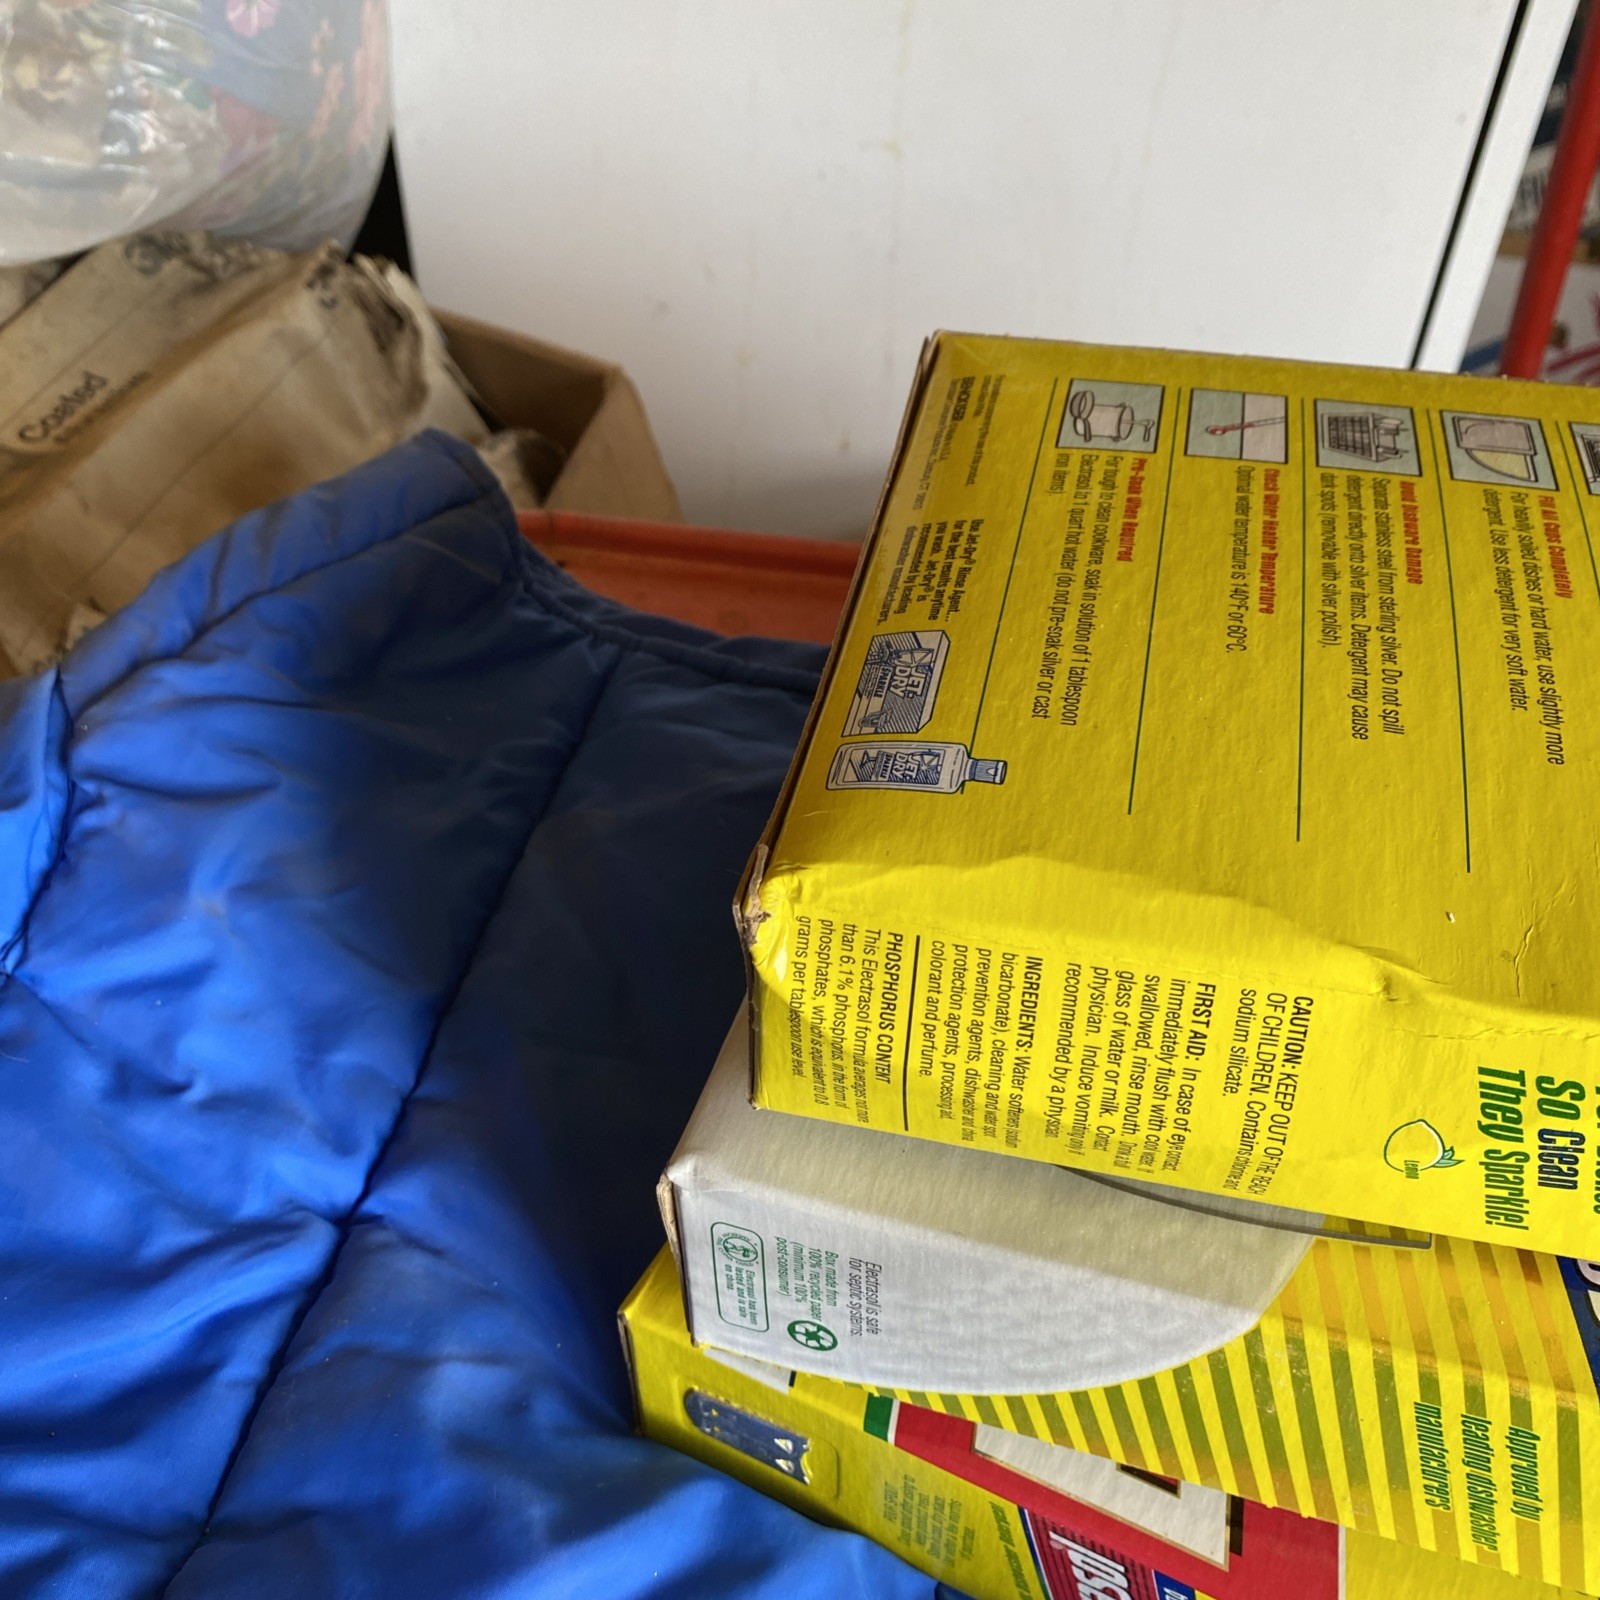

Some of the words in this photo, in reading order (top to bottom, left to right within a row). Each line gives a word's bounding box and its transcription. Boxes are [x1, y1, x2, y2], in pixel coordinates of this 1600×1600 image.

[1127, 457, 1147, 494] Pre-Soak
[1067, 508, 1085, 530] quart
[1095, 501, 1115, 523] clean
[1123, 496, 1140, 519] When
[1064, 530, 1084, 545] hot
[1085, 523, 1109, 567] cookware,
[1116, 521, 1138, 562] Required
[1230, 518, 1251, 570] temperature
[1374, 510, 1393, 548] stainless
[1059, 546, 1078, 571] water
[1348, 542, 1367, 563] onto
[1376, 548, 1395, 570] steel
[1492, 546, 1510, 565] less
[1517, 534, 1539, 561] soiled
[1055, 572, 1076, 588] (do
[1083, 568, 1102, 591] soak
[1349, 564, 1368, 591] silver
[1377, 571, 1396, 594] from
[1493, 565, 1518, 612] detergent
[1521, 561, 1542, 592] dishes
[1052, 589, 1071, 605] not
[1350, 591, 1368, 620] items.
[1044, 606, 1066, 650] pre-soak
[1074, 602, 1097, 637] solution
[1376, 595, 1398, 634] sterling
[1529, 605, 1549, 630] hard
[1072, 638, 1092, 655] of
[1347, 623, 1371, 676] Detergent
[1379, 634, 1400, 665] silver.
[1500, 629, 1521, 653] very
[1532, 631, 1552, 662] water,
[889, 667, 910, 696] DRY
[1038, 650, 1061, 679] silver
[1505, 654, 1526, 676] soft
[1536, 664, 1555, 685] use
[905, 667, 924, 698] JET-
[1060, 666, 1088, 726] tablespoon
[1348, 677, 1368, 703] may
[1381, 686, 1402, 707] not
[1508, 678, 1529, 711] water.
[1030, 694, 1050, 719] cast
[1380, 708, 1404, 734] spill
[1536, 685, 1562, 730] slightly
[1544, 731, 1564, 765] more
[794, 915, 811, 958] grams
[840, 923, 858, 952] than
[862, 929, 881, 956] This
[790, 960, 806, 985] per
[811, 918, 836, 1000] phosphates,
[836, 954, 856, 990] 6.1%
[927, 940, 946, 994] colorant
[856, 958, 878, 1023] Electrasol
[878, 931, 903, 1031] PHOSPHORUS
[948, 943, 968, 1010] protection
[971, 947, 991, 1017] prevention
[992, 951, 1017, 1032] bicarbonate),
[1114, 970, 1136, 1008] glass
[786, 987, 806, 1042] tablespoon
[924, 995, 939, 1021] and
[1015, 956, 1043, 1052] INGREDIENTS:
[1054, 962, 1081, 1064] recommended
[1084, 965, 1111, 1036] physician.
[1134, 974, 1160, 1049] swallowed,
[1189, 982, 1216, 1031] FIRST
[1265, 992, 1287, 1014] OF
[809, 1005, 827, 1038] which
[829, 993, 850, 1061] phosphorus,
[941, 1012, 961, 1058] agents,
[1112, 1010, 1130, 1027] of
[1154, 978, 1186, 1065] immediately
[1232, 988, 1256, 1048] sodium
[1281, 996, 1313, 1068] CAUTION:
[852, 1025, 871, 1067] formula
[918, 1022, 936, 1080] perfume.
[964, 1018, 984, 1064] agents,
[1106, 1028, 1126, 1068] water
[1184, 1028, 1207, 1060] AID:
[1248, 1015, 1282, 1096] CHILDREN.
[791, 1056, 806, 1081] level.
[808, 1046, 826, 1088] equivalent
[874, 1033, 893, 1084] CONTENT
[985, 1038, 1008, 1091] cleaning
[1010, 1055, 1031, 1091] Water
[1048, 1066, 1070, 1084] by
[1077, 1044, 1102, 1090] Induce
[1128, 1055, 1147, 1090] rinse
[1181, 1067, 1201, 1081] In
[1222, 1050, 1248, 1096] silicate.
[832, 1083, 848, 1101] form
[937, 1060, 956, 1109] processing
[962, 1067, 982, 1117] dishwasher
[1103, 1069, 1120, 1085] or
[1152, 1066, 1175, 1100] flush
[1273, 1071, 1298, 1111] KEEP
[984, 1091, 1000, 1110] and
[1098, 1086, 1117, 1117] milk.
[1120, 1091, 1141, 1136] mouth.
[1175, 1083, 1194, 1115] case
[1477, 1066, 1526, 1143] They
[1536, 1075, 1585, 1120] So
[1043, 1095, 1064, 1137] physician.
[1069, 1093, 1091, 1138] vomiting
[1146, 1103, 1166, 1132] with
[1172, 1117, 1190, 1132] of
[1236, 1100, 1266, 1156] Contains
[1266, 1113, 1290, 1146] OUT
[1143, 1133, 1160, 1151] cool
[1166, 1133, 1186, 1150] eye
[1263, 1146, 1283, 1162] OF
[1537, 1127, 1584, 1190] Clean
[1404, 1160, 1419, 1179] Lemon
[1478, 1148, 1528, 1230] Sparkle!
[825, 1266, 838, 1288] made
[848, 1256, 865, 1272] for
[825, 1288, 837, 1306] from
[847, 1272, 864, 1300] septic
[864, 1260, 882, 1307] Electrasol
[808, 1300, 821, 1320] paper
[847, 1300, 863, 1336] systems.
[865, 1315, 878, 1334] safe
[1413, 1401, 1451, 1510] manufacturers
[1460, 1413, 1493, 1473] leading
[1506, 1425, 1542, 1503] Approved
[1465, 1472, 1498, 1551] dishwasher
[1510, 1500, 1542, 1521] by
